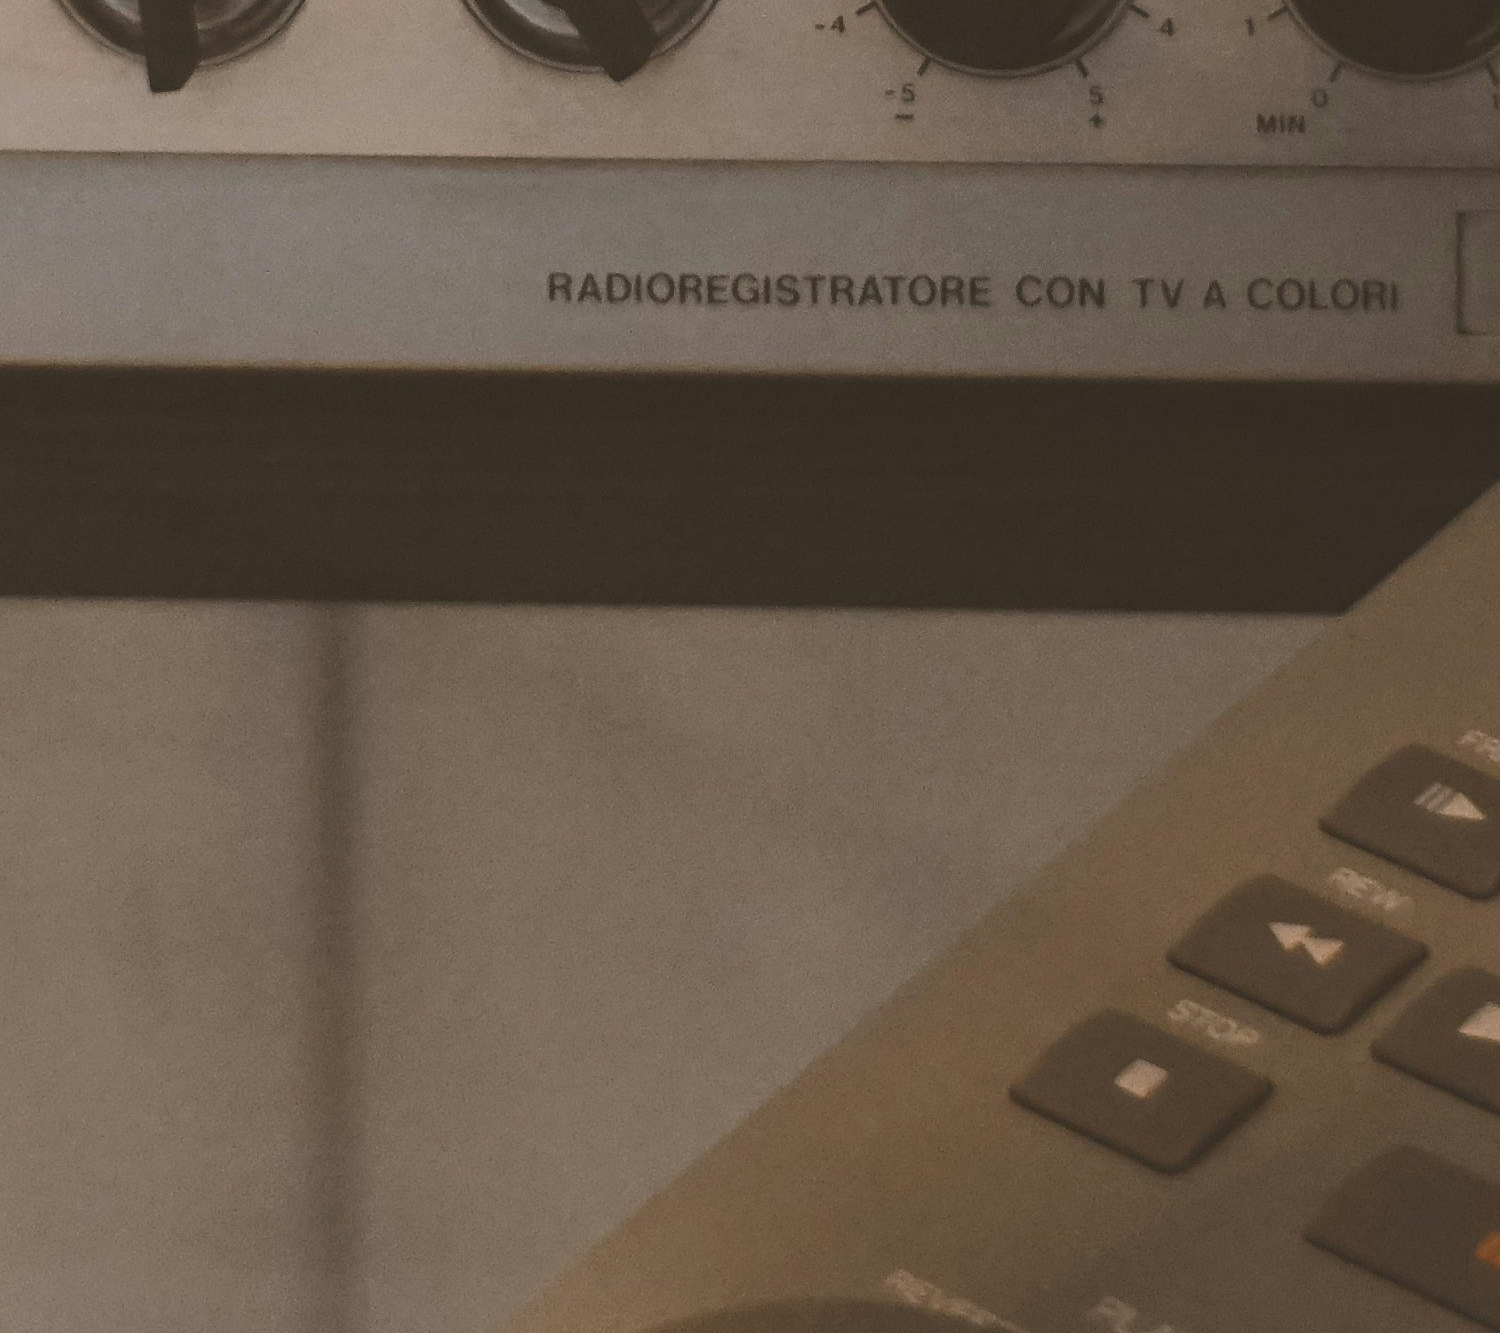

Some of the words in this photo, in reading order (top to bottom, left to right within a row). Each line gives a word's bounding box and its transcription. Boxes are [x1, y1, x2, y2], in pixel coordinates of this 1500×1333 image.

[1160, 18, 1174, 37] 4
[1245, 18, 1254, 36] 1
[1088, 86, 1103, 105] 5
[1312, 89, 1328, 109] 0
[1257, 114, 1306, 134] MIN
[547, 271, 991, 309] RADIOREGISTRATORE
[1015, 273, 1107, 311] CON
[1131, 278, 1185, 311] TV
[1202, 279, 1228, 311] A
[1246, 277, 1400, 313] COLORI
[1329, 866, 1414, 914] REW
[1167, 998, 1260, 1045] STOP
